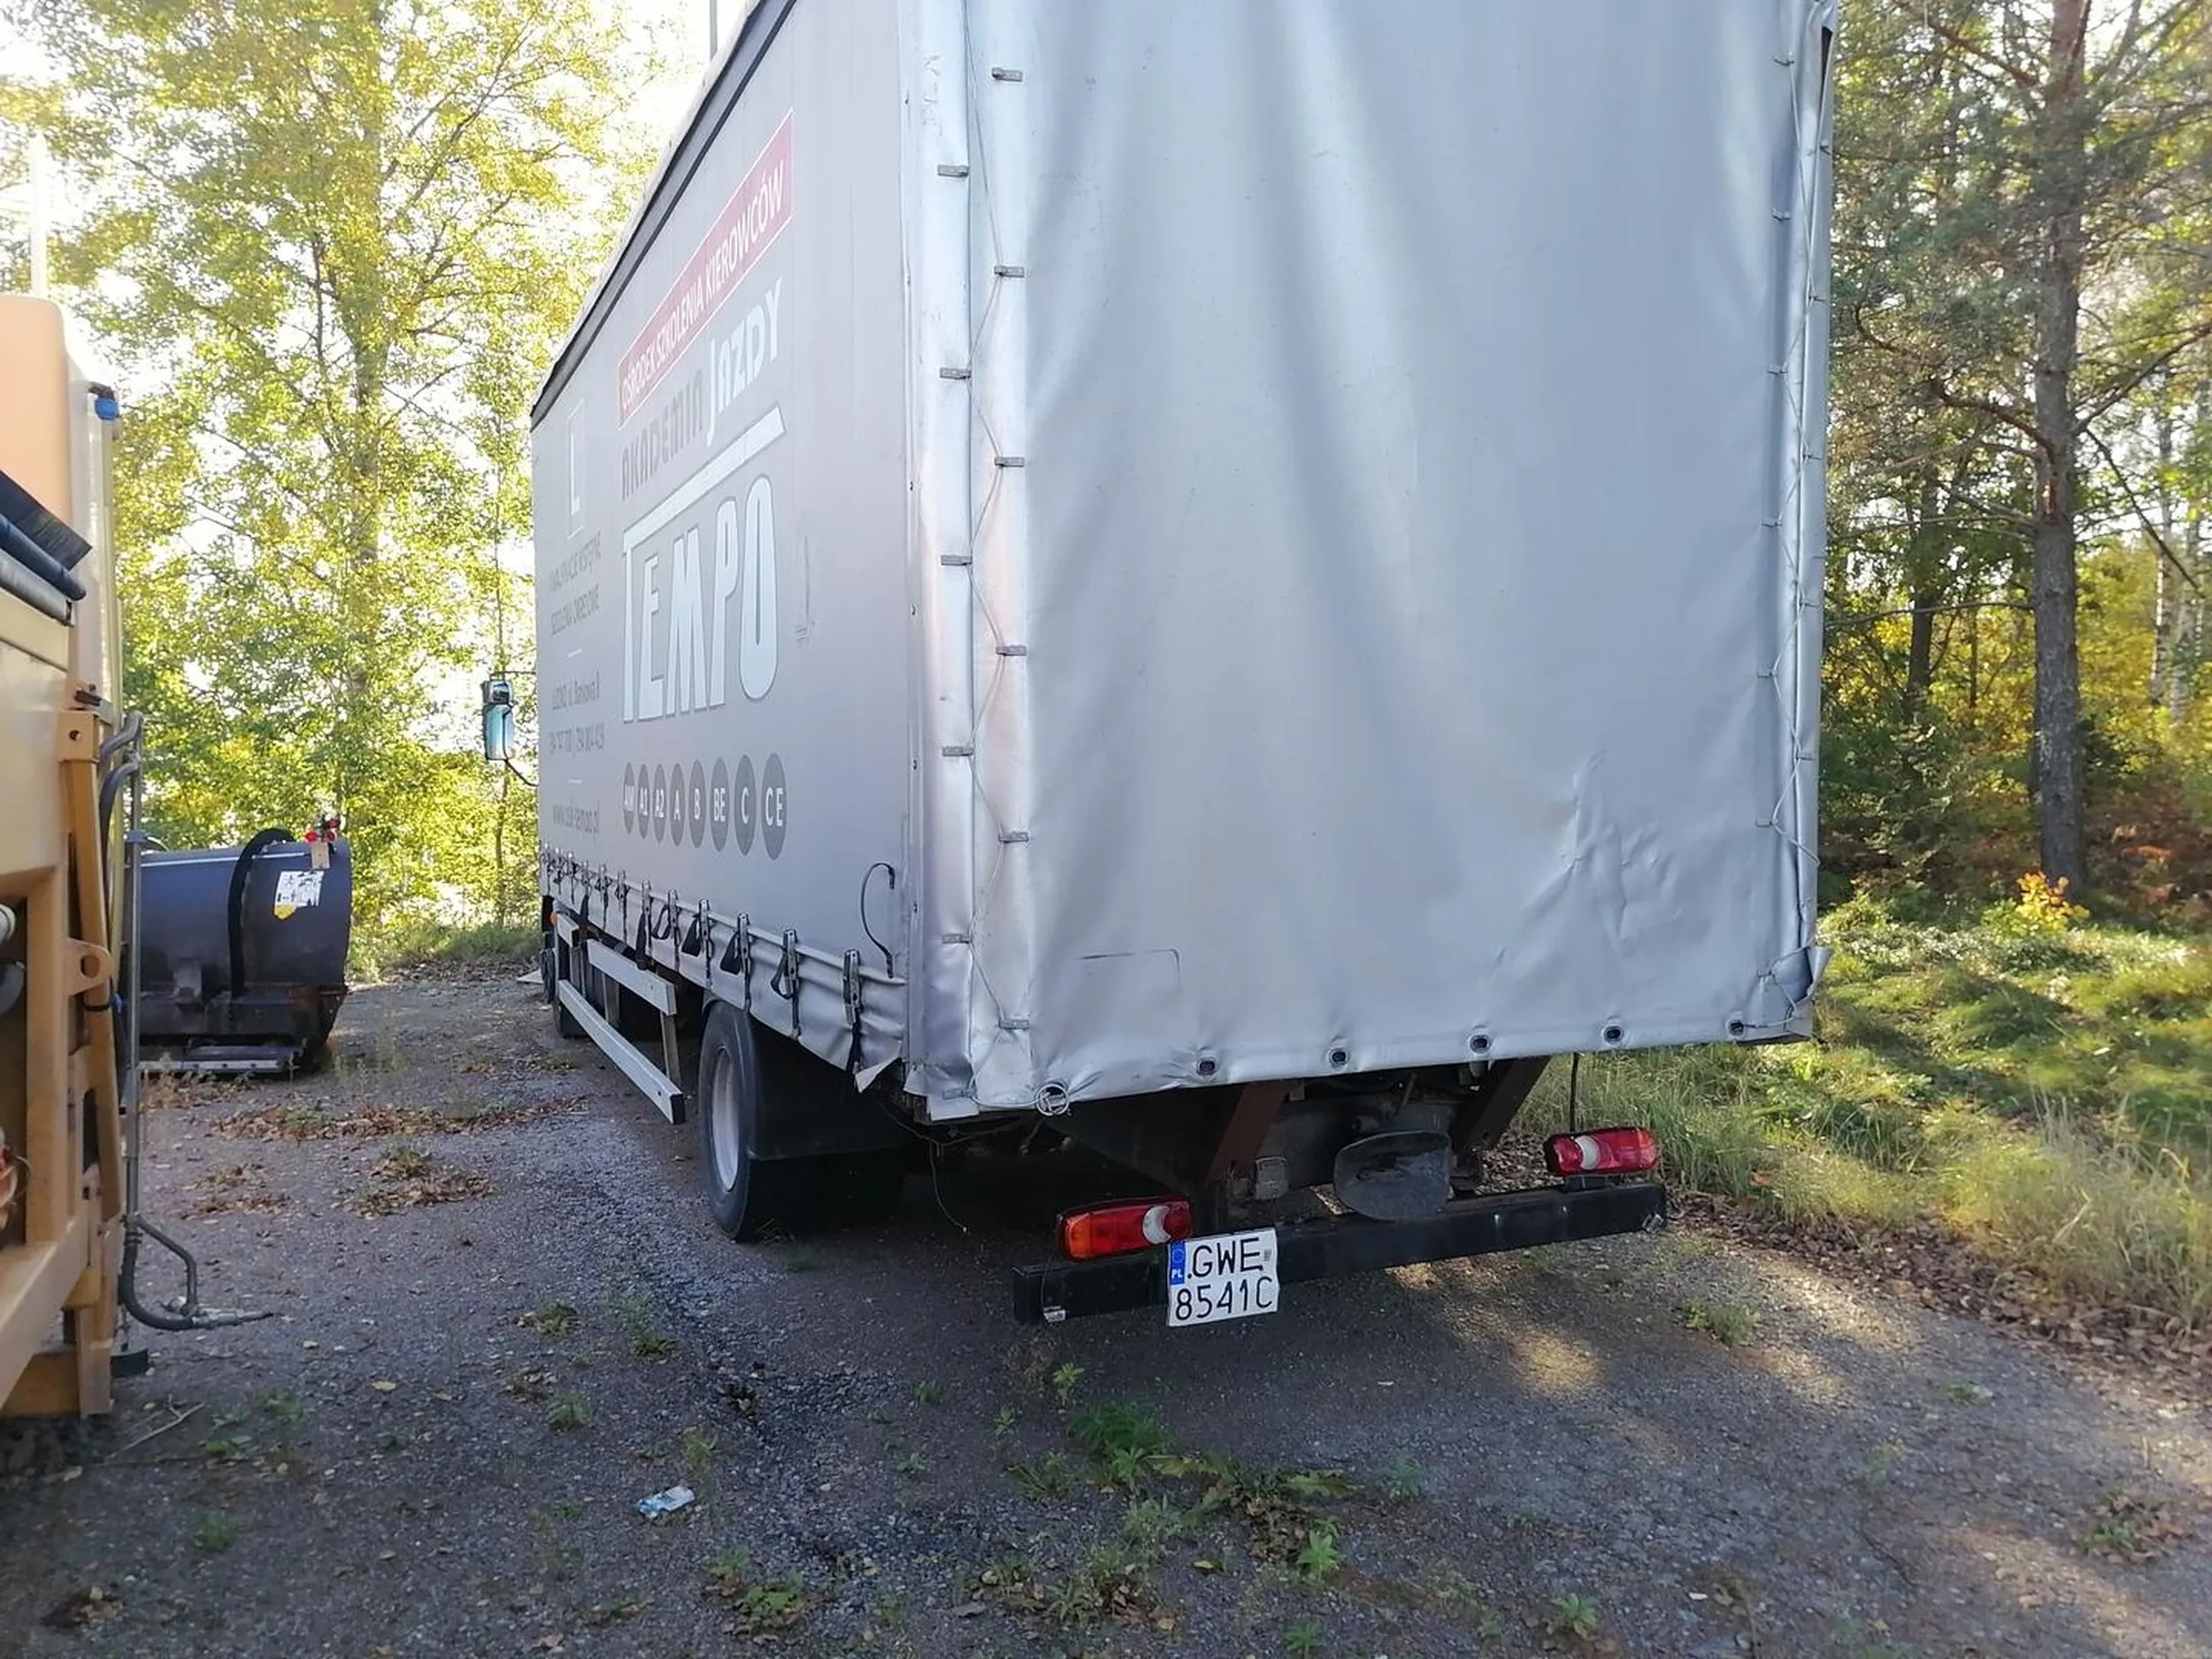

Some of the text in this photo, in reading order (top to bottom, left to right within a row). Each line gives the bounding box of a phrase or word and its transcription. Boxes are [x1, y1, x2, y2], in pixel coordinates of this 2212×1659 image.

[657, 276, 706, 371] SZKOLENIA
[706, 159, 785, 300] KIEROWCÓW
[621, 276, 783, 502] AKADEMIA JAZDY
[621, 402, 786, 723] TEMPO
[639, 787, 649, 816] A1
[654, 788, 664, 818] A2
[673, 789, 681, 821] A
[694, 787, 702, 820] B
[713, 787, 726, 822] BE
[741, 786, 749, 825] C
[765, 786, 784, 827] CE
[1171, 1268, 1183, 1279] PL
[1192, 1237, 1263, 1278] GWE
[1175, 1275, 1273, 1321] 8541C
